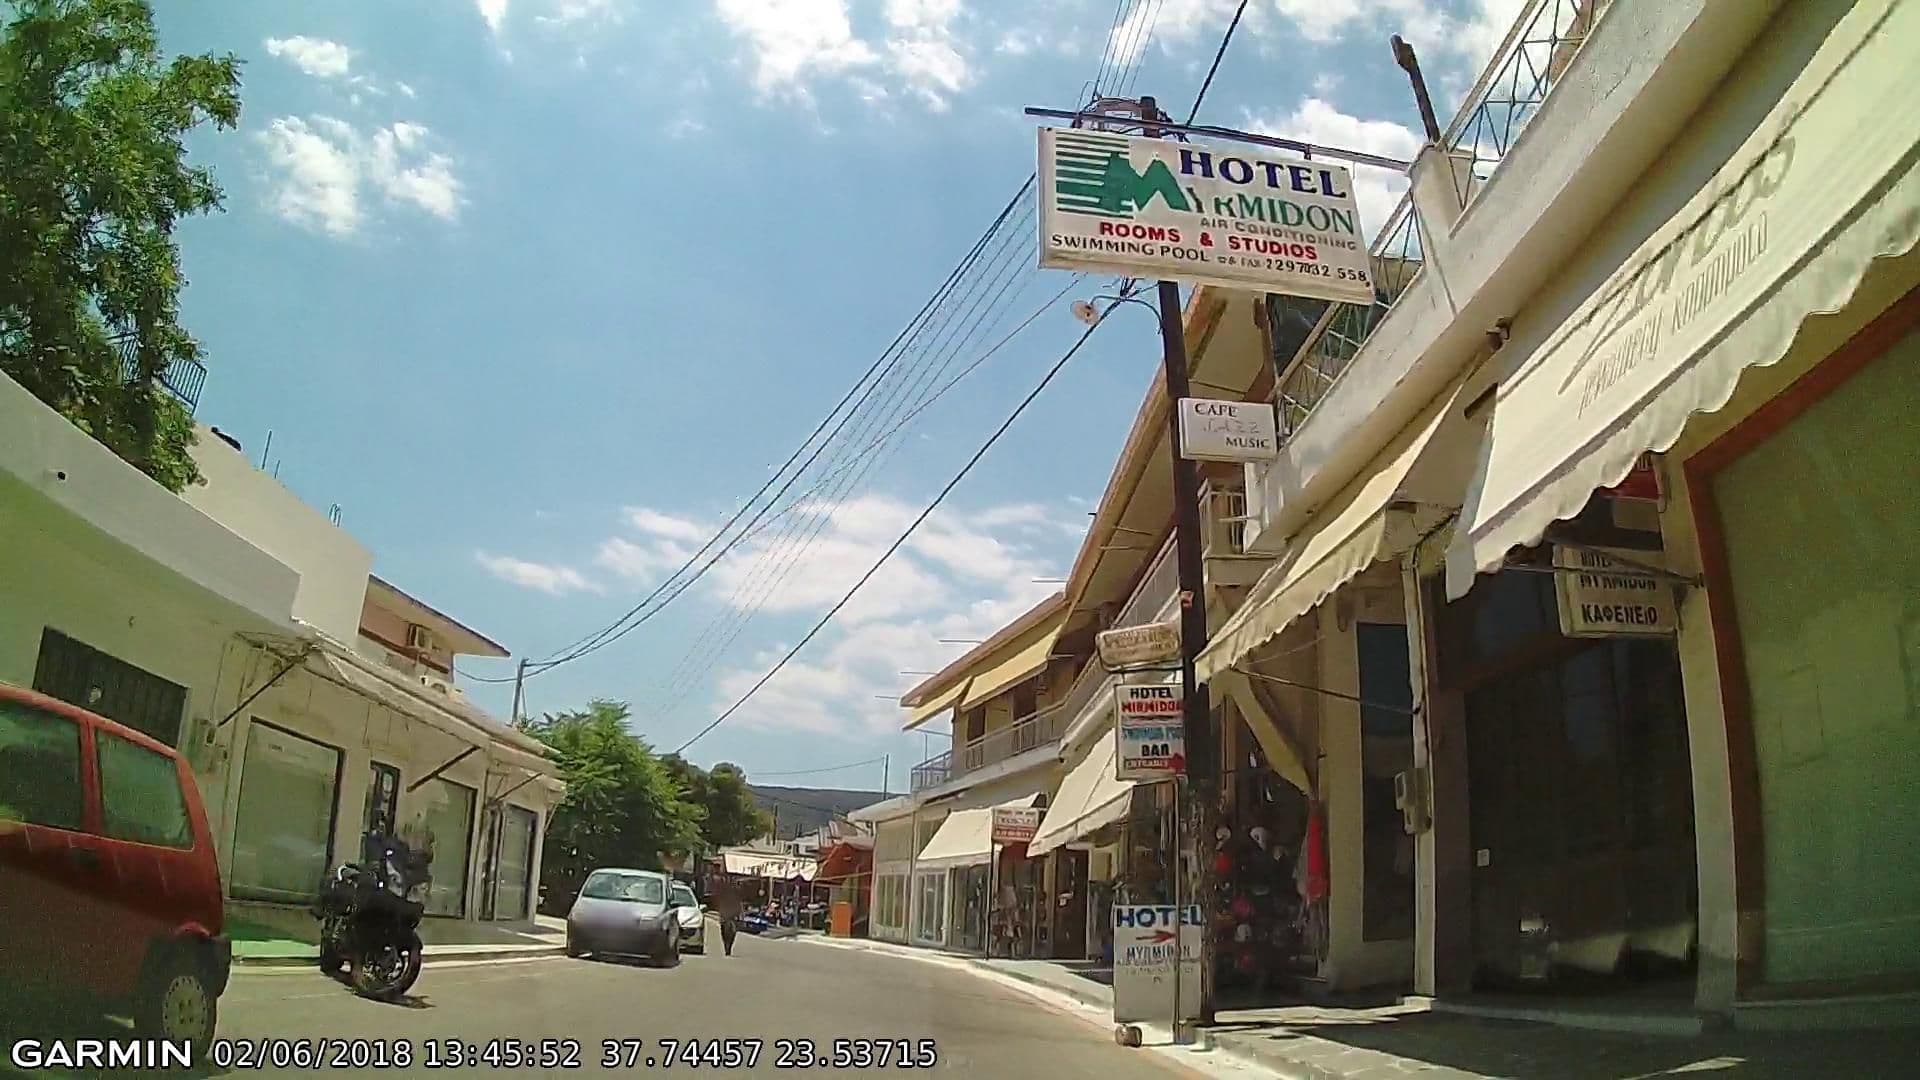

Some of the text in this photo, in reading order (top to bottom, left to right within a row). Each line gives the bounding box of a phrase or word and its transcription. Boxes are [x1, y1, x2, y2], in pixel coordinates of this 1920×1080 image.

[1180, 149, 1348, 199] HOTEL
[1100, 221, 1318, 260] ROOMS & STUDIOS
[1201, 217, 1357, 251] AIR CONDITIONING
[1052, 233, 1154, 256] SWIMMING
[1160, 245, 1210, 262] POOL
[1194, 402, 1239, 418] CAFE
[1225, 436, 1270, 450] MUSIC
[1582, 603, 1658, 625] ΚΑΦΕΝΕΙΟ
[1129, 686, 1173, 699] HOTEL
[1116, 903, 1202, 928] HOTEL
